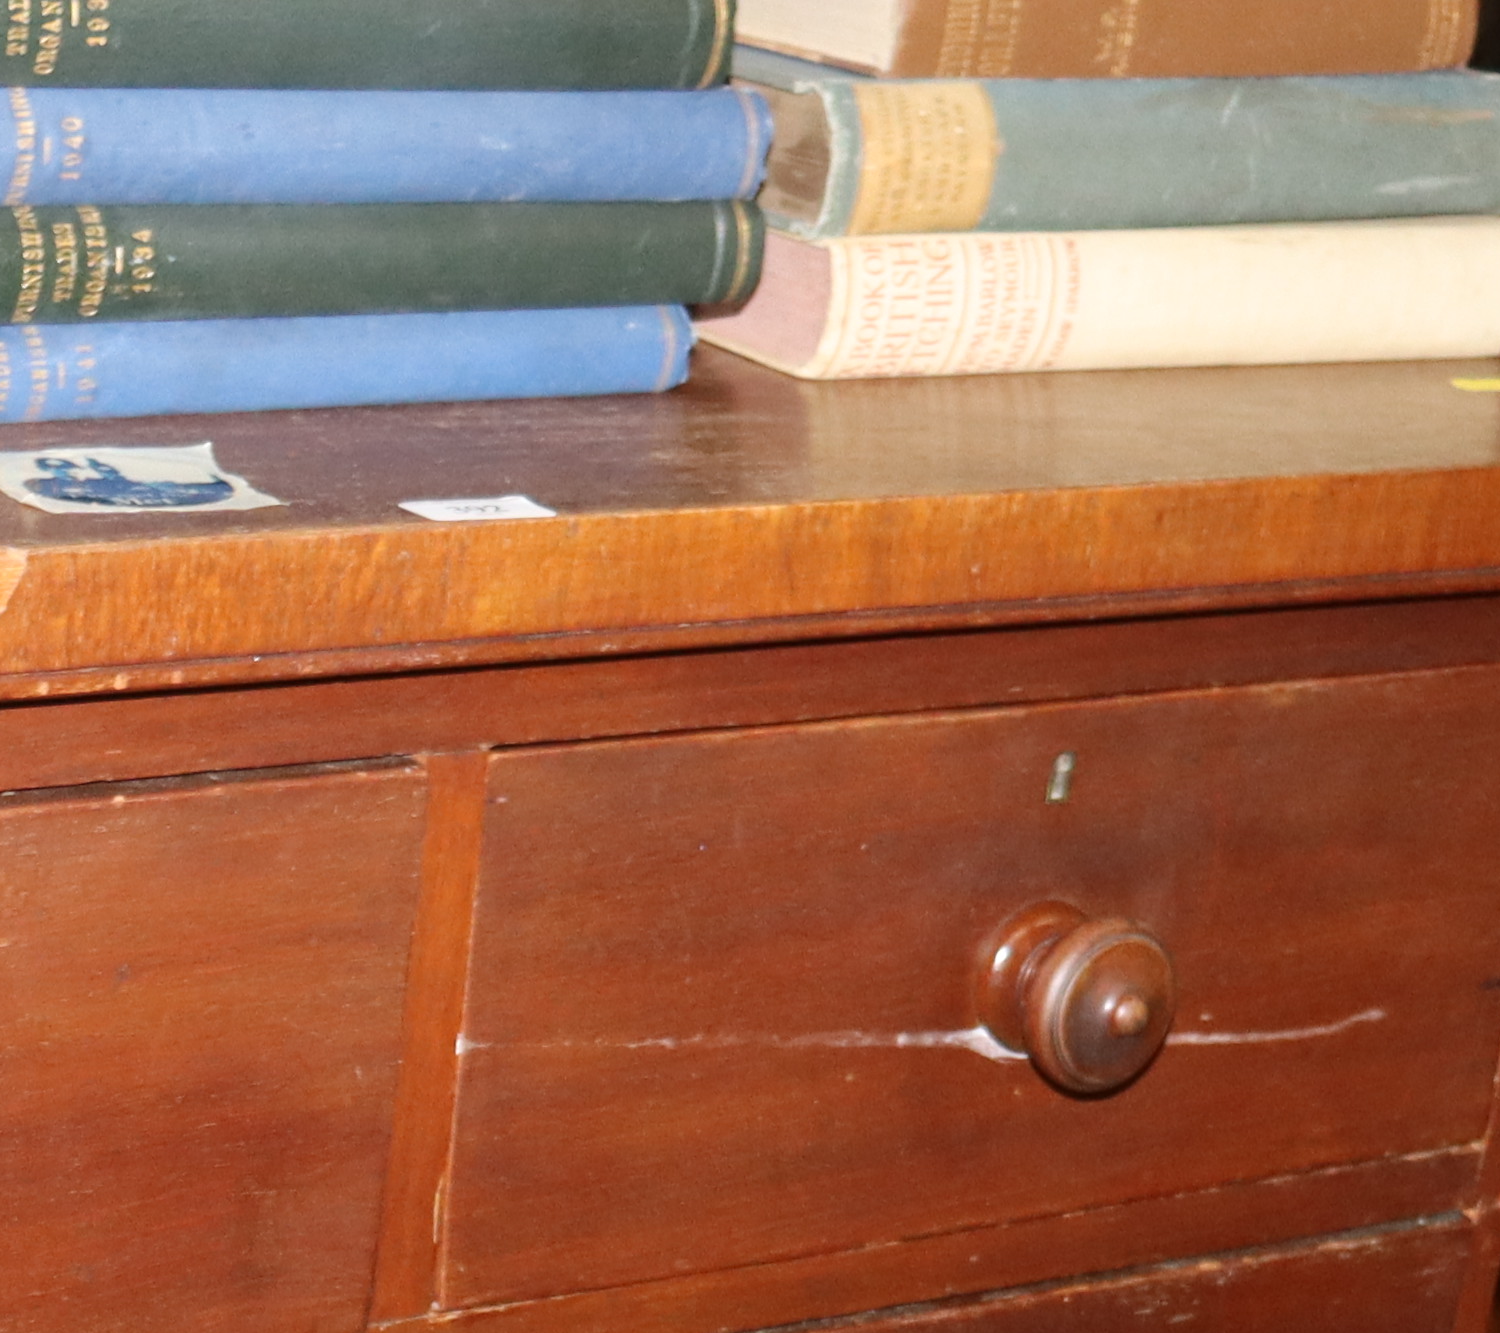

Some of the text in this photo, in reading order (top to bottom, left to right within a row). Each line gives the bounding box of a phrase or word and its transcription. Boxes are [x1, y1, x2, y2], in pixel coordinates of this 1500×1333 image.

[59, 116, 84, 180] 1940
[53, 223, 77, 303] TRADES
[131, 228, 156, 293] 1934
[849, 281, 885, 360] BOOK
